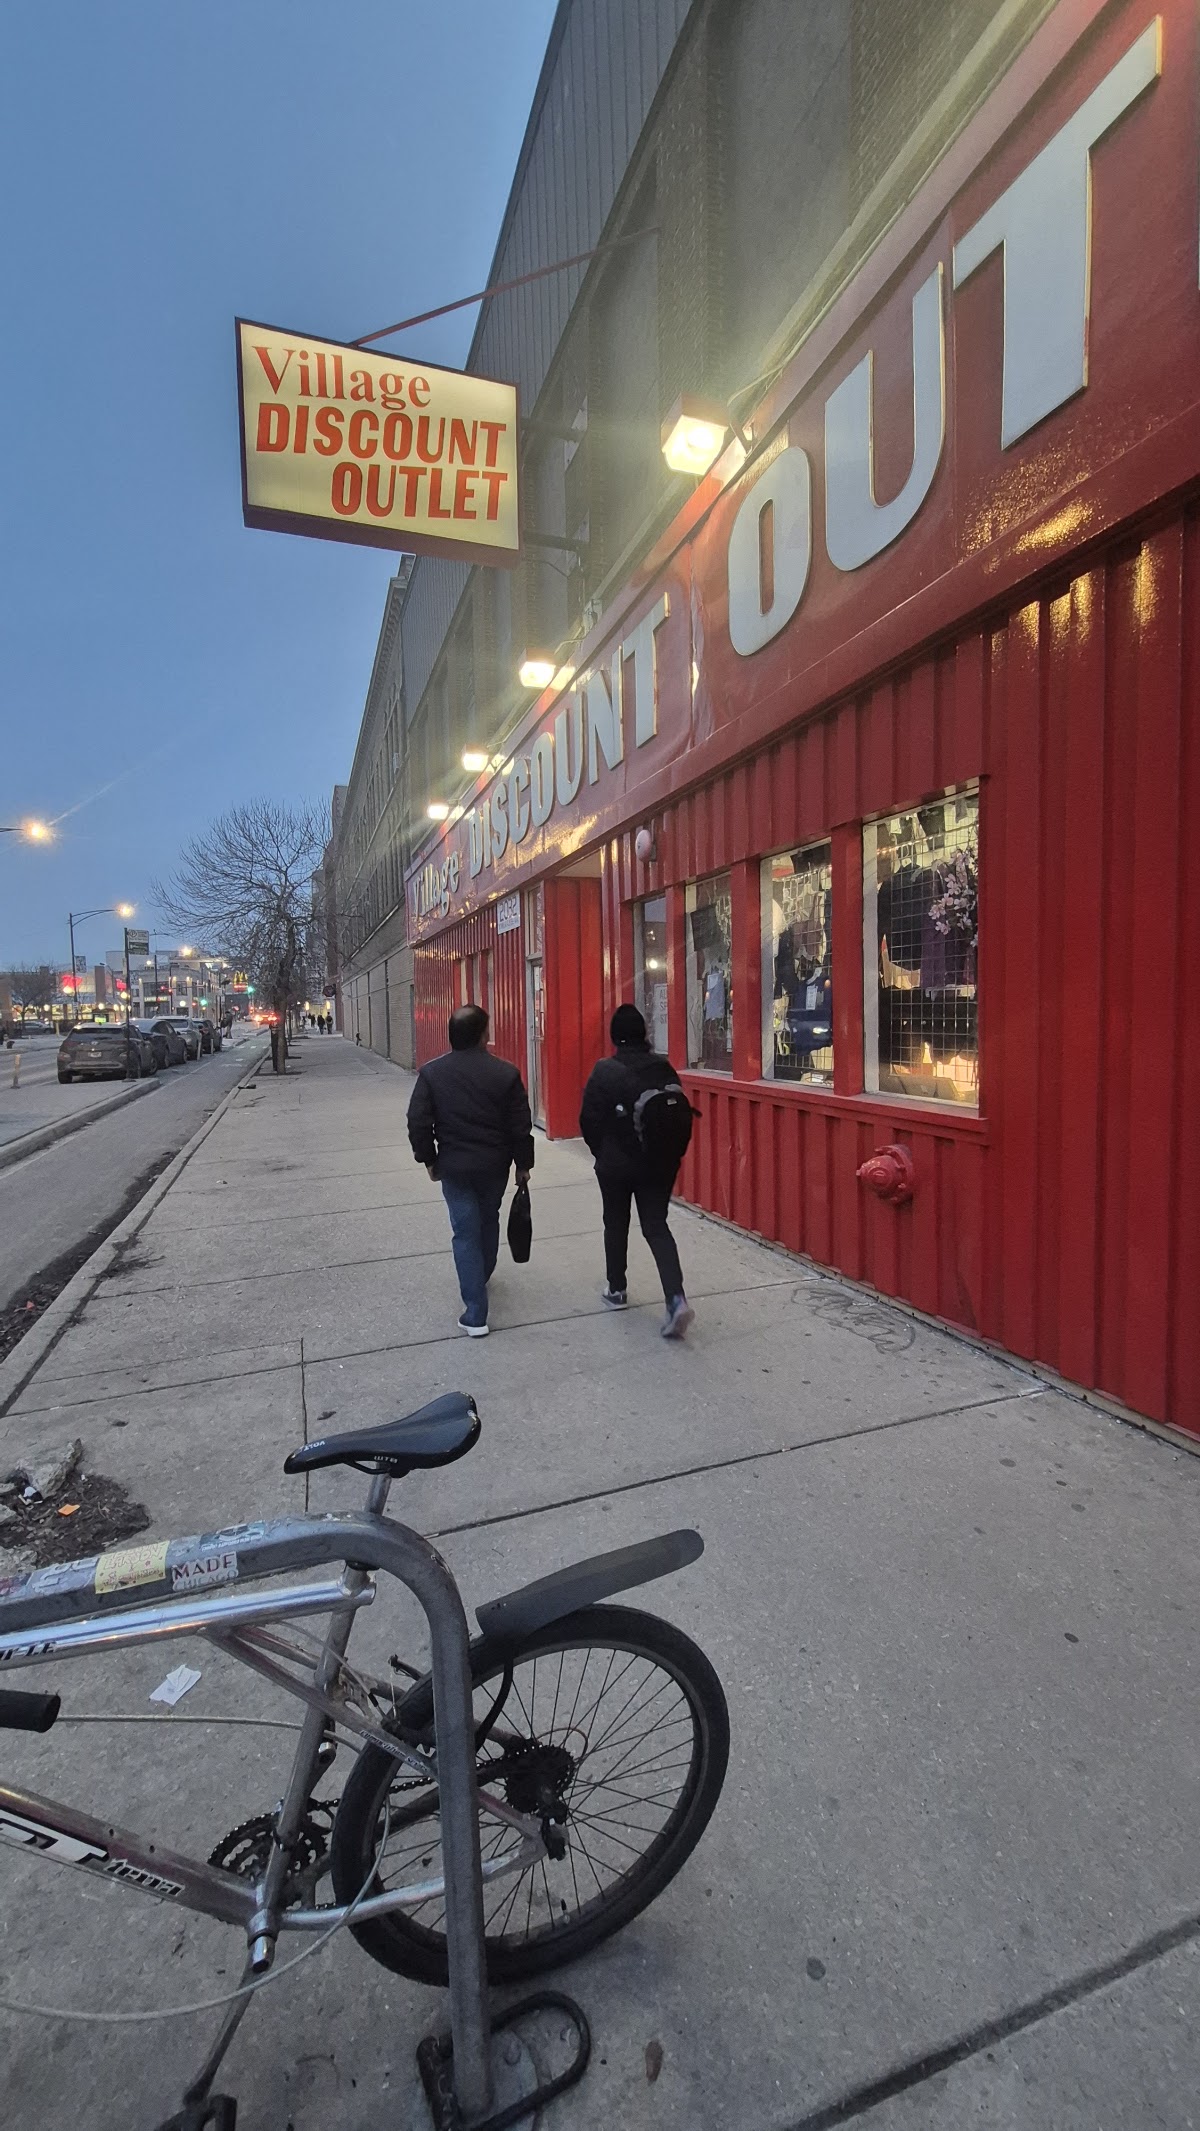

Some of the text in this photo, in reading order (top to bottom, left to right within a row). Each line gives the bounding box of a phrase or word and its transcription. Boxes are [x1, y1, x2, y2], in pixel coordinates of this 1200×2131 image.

[251, 346, 432, 411] Village
[256, 402, 507, 468] DISCOUNT
[331, 461, 508, 521] OUTLET
[413, 851, 459, 918] Village
[468, 592, 670, 879] DISCOUNT
[174, 1551, 236, 1580] MADE
